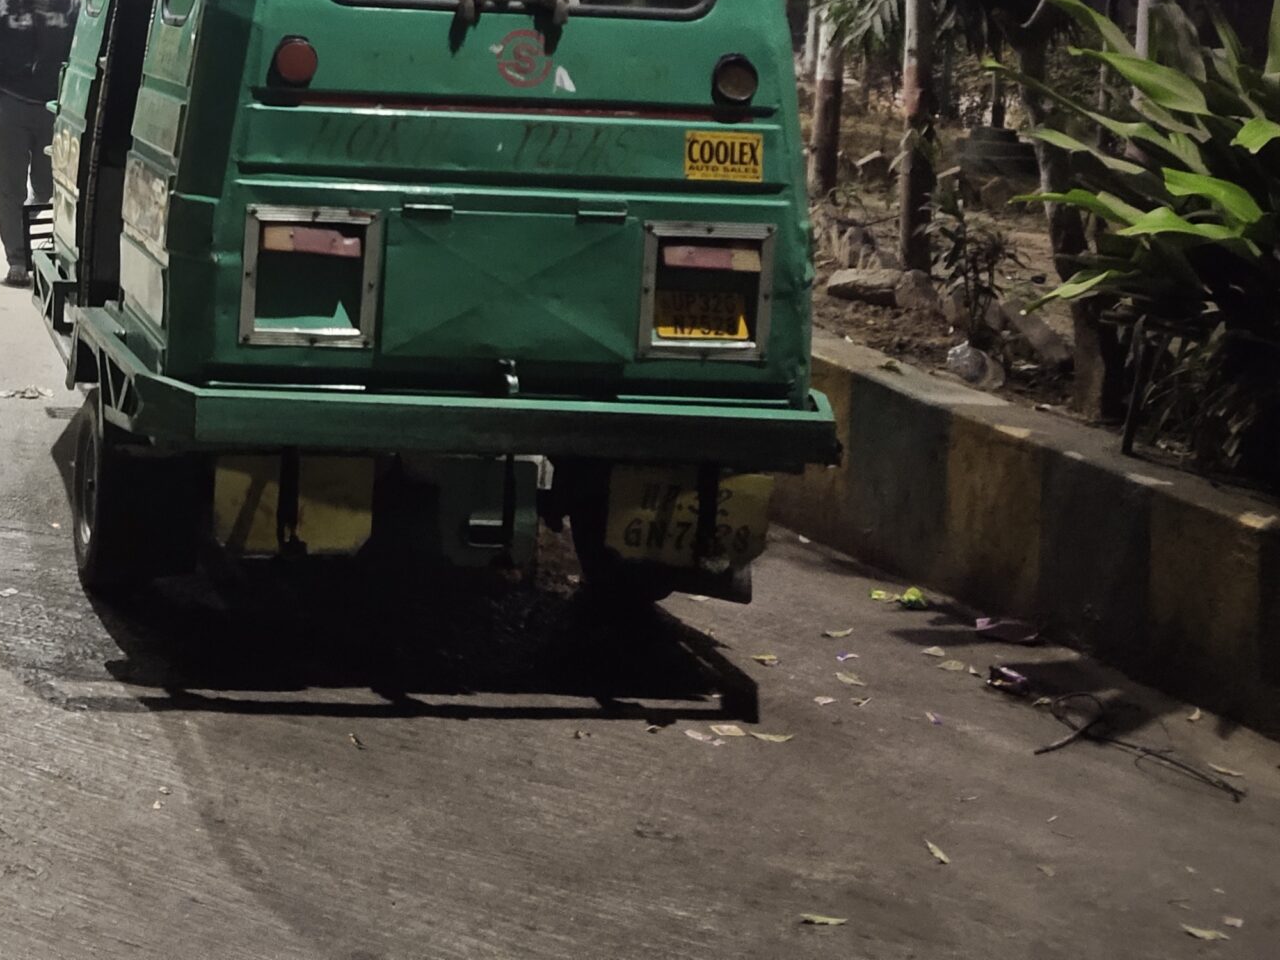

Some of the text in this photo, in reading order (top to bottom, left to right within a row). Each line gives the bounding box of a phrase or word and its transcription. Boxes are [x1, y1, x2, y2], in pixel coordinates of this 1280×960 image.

[687, 138, 760, 167] COOLEX
[688, 165, 758, 174] AUTO SALES
